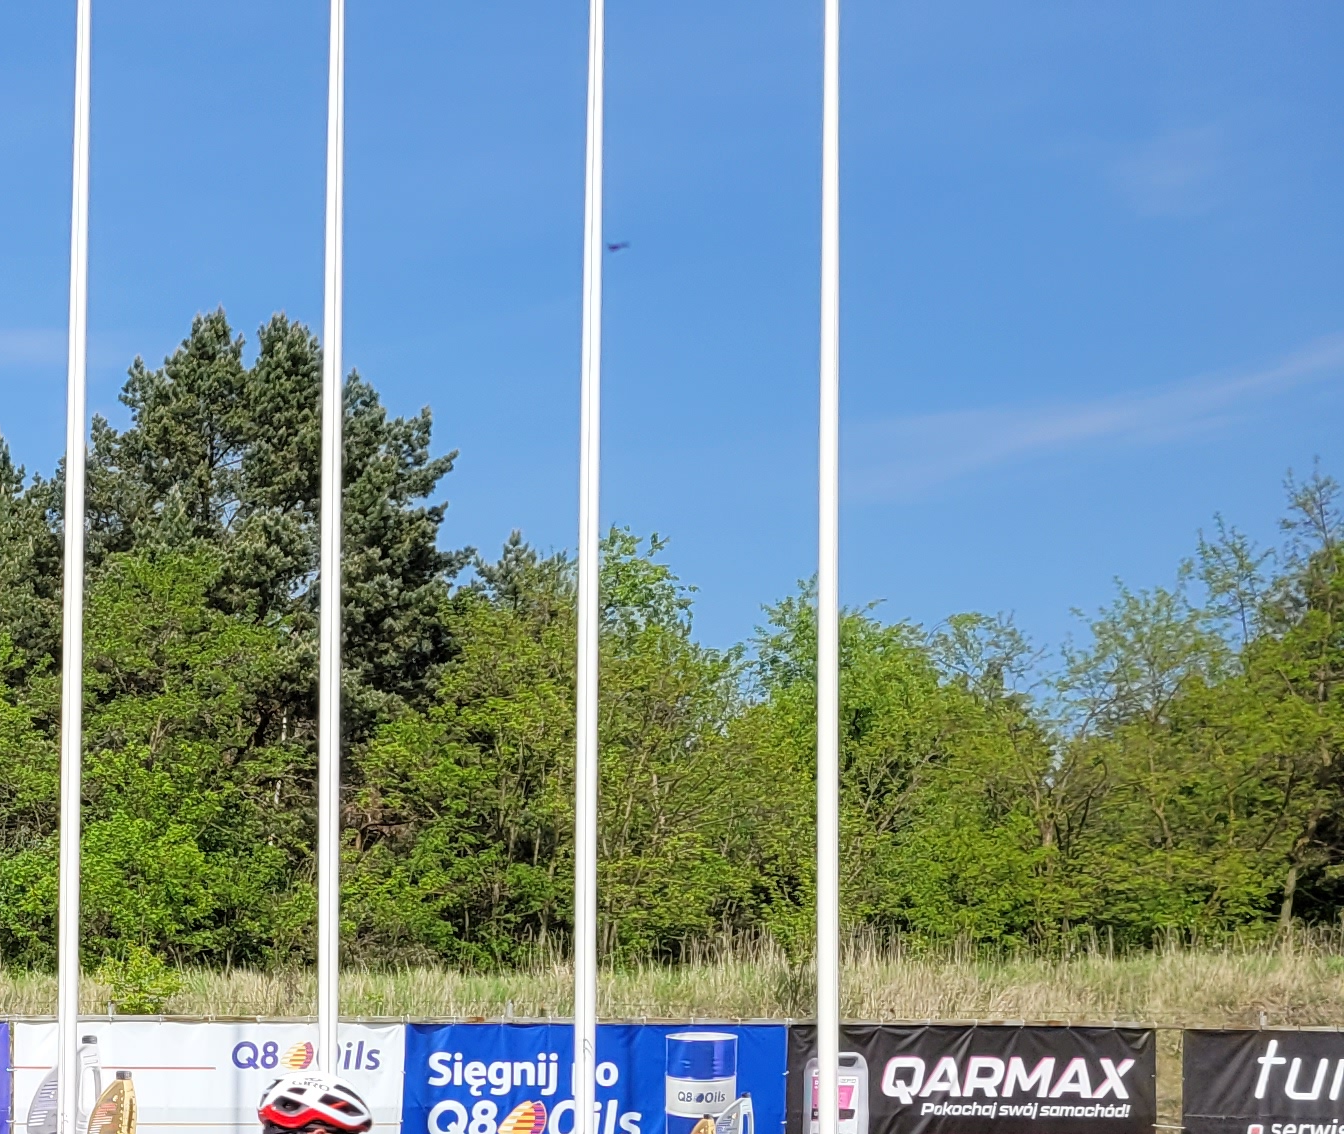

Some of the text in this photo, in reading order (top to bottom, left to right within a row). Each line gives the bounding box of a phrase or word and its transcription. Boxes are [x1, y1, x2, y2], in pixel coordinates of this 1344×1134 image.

[232, 1041, 279, 1070] Q8
[428, 1051, 619, 1097] Sięgnij o
[881, 1056, 1135, 1105] QARMAX
[677, 1091, 726, 1104] Q8 Oils
[921, 1103, 1131, 1119] Pokochaj swój samochód!
